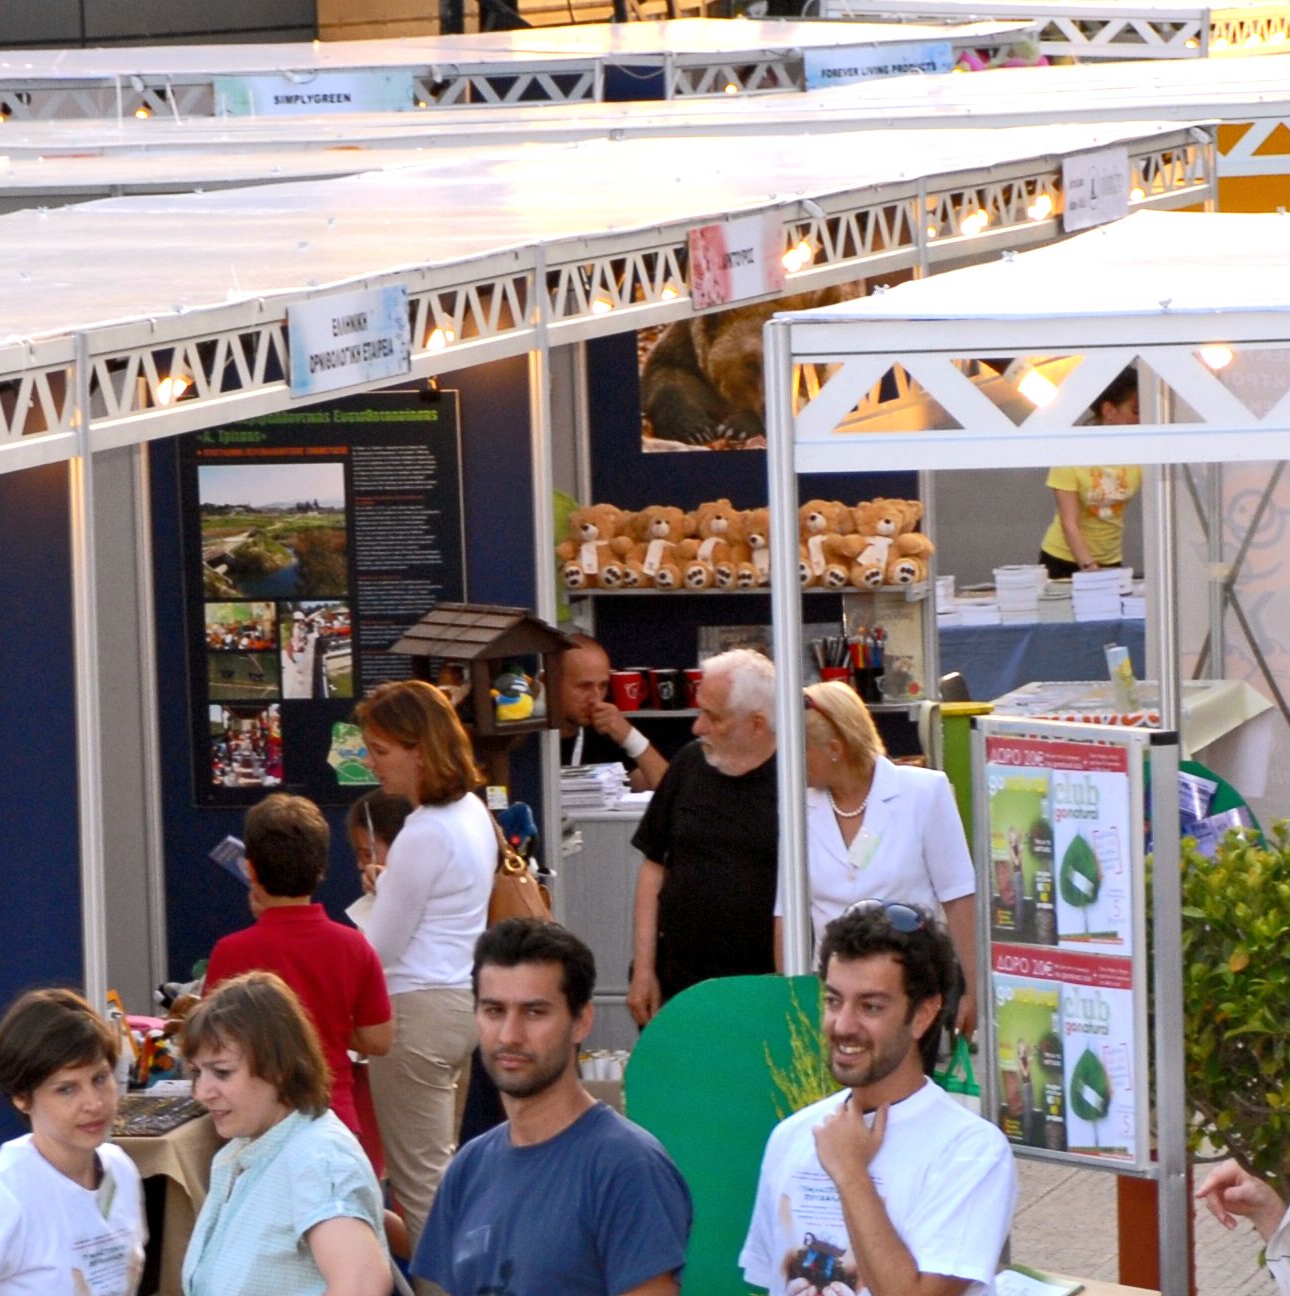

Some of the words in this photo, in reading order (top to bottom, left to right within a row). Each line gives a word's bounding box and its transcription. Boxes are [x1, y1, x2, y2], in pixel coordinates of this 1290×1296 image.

[820, 67, 858, 78] FOREVER
[861, 65, 889, 76] LIVING
[892, 61, 937, 74] PRODUCTS
[272, 92, 352, 105] SIMPLYGREEN
[1054, 773, 1101, 806] club
[1065, 987, 1110, 1022] club
